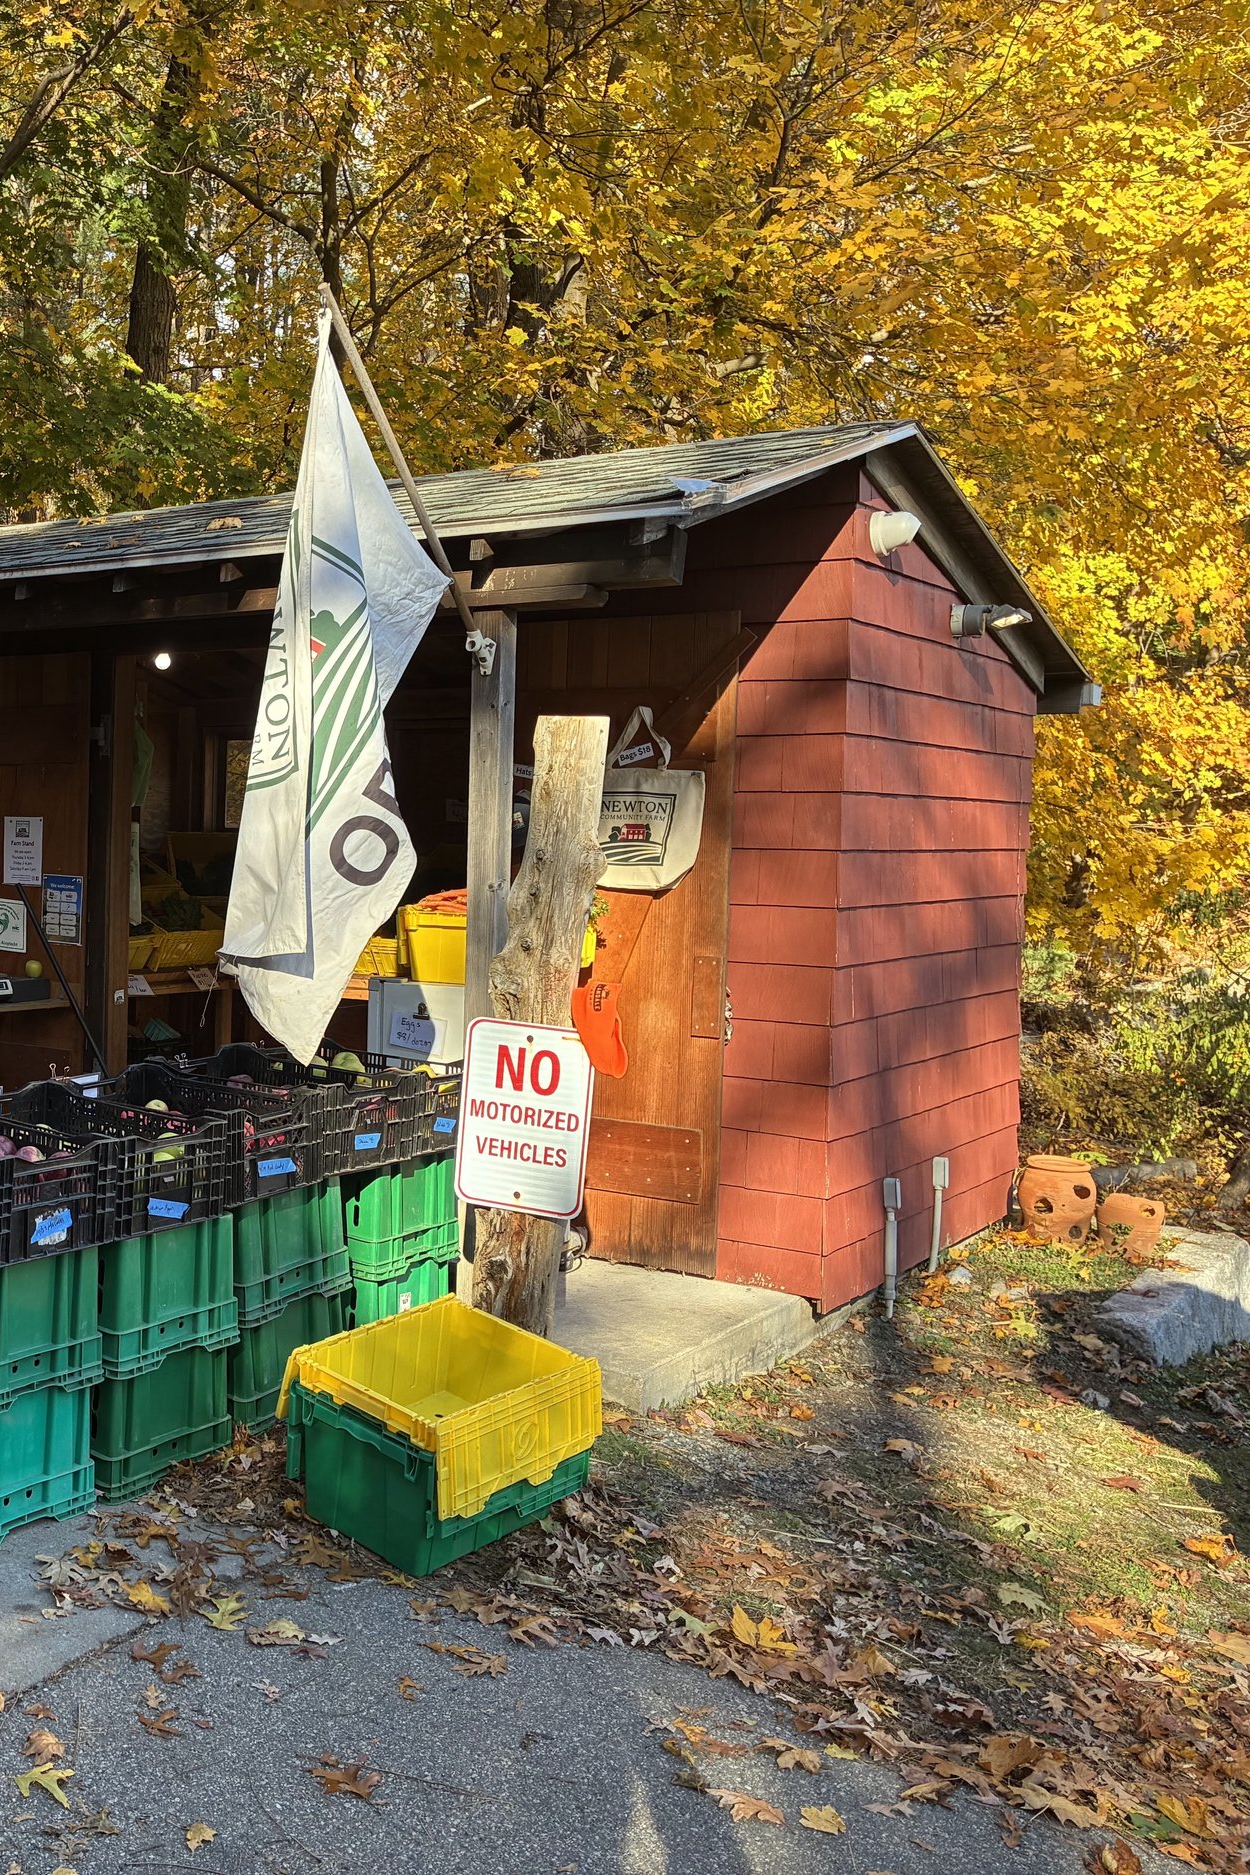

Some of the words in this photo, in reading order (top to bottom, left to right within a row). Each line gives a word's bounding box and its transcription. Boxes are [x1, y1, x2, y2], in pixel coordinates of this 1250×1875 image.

[619, 751, 638, 762] Bags
[638, 745, 652, 756] $18
[516, 767, 532, 776] Hats
[601, 800, 669, 814] NEWTON
[645, 814, 666, 822] FARM
[400, 1017, 421, 1034] Eggs
[495, 1044, 561, 1096] NO
[469, 1098, 580, 1133] MOTORIZED
[475, 1135, 568, 1168] VEHICLES
